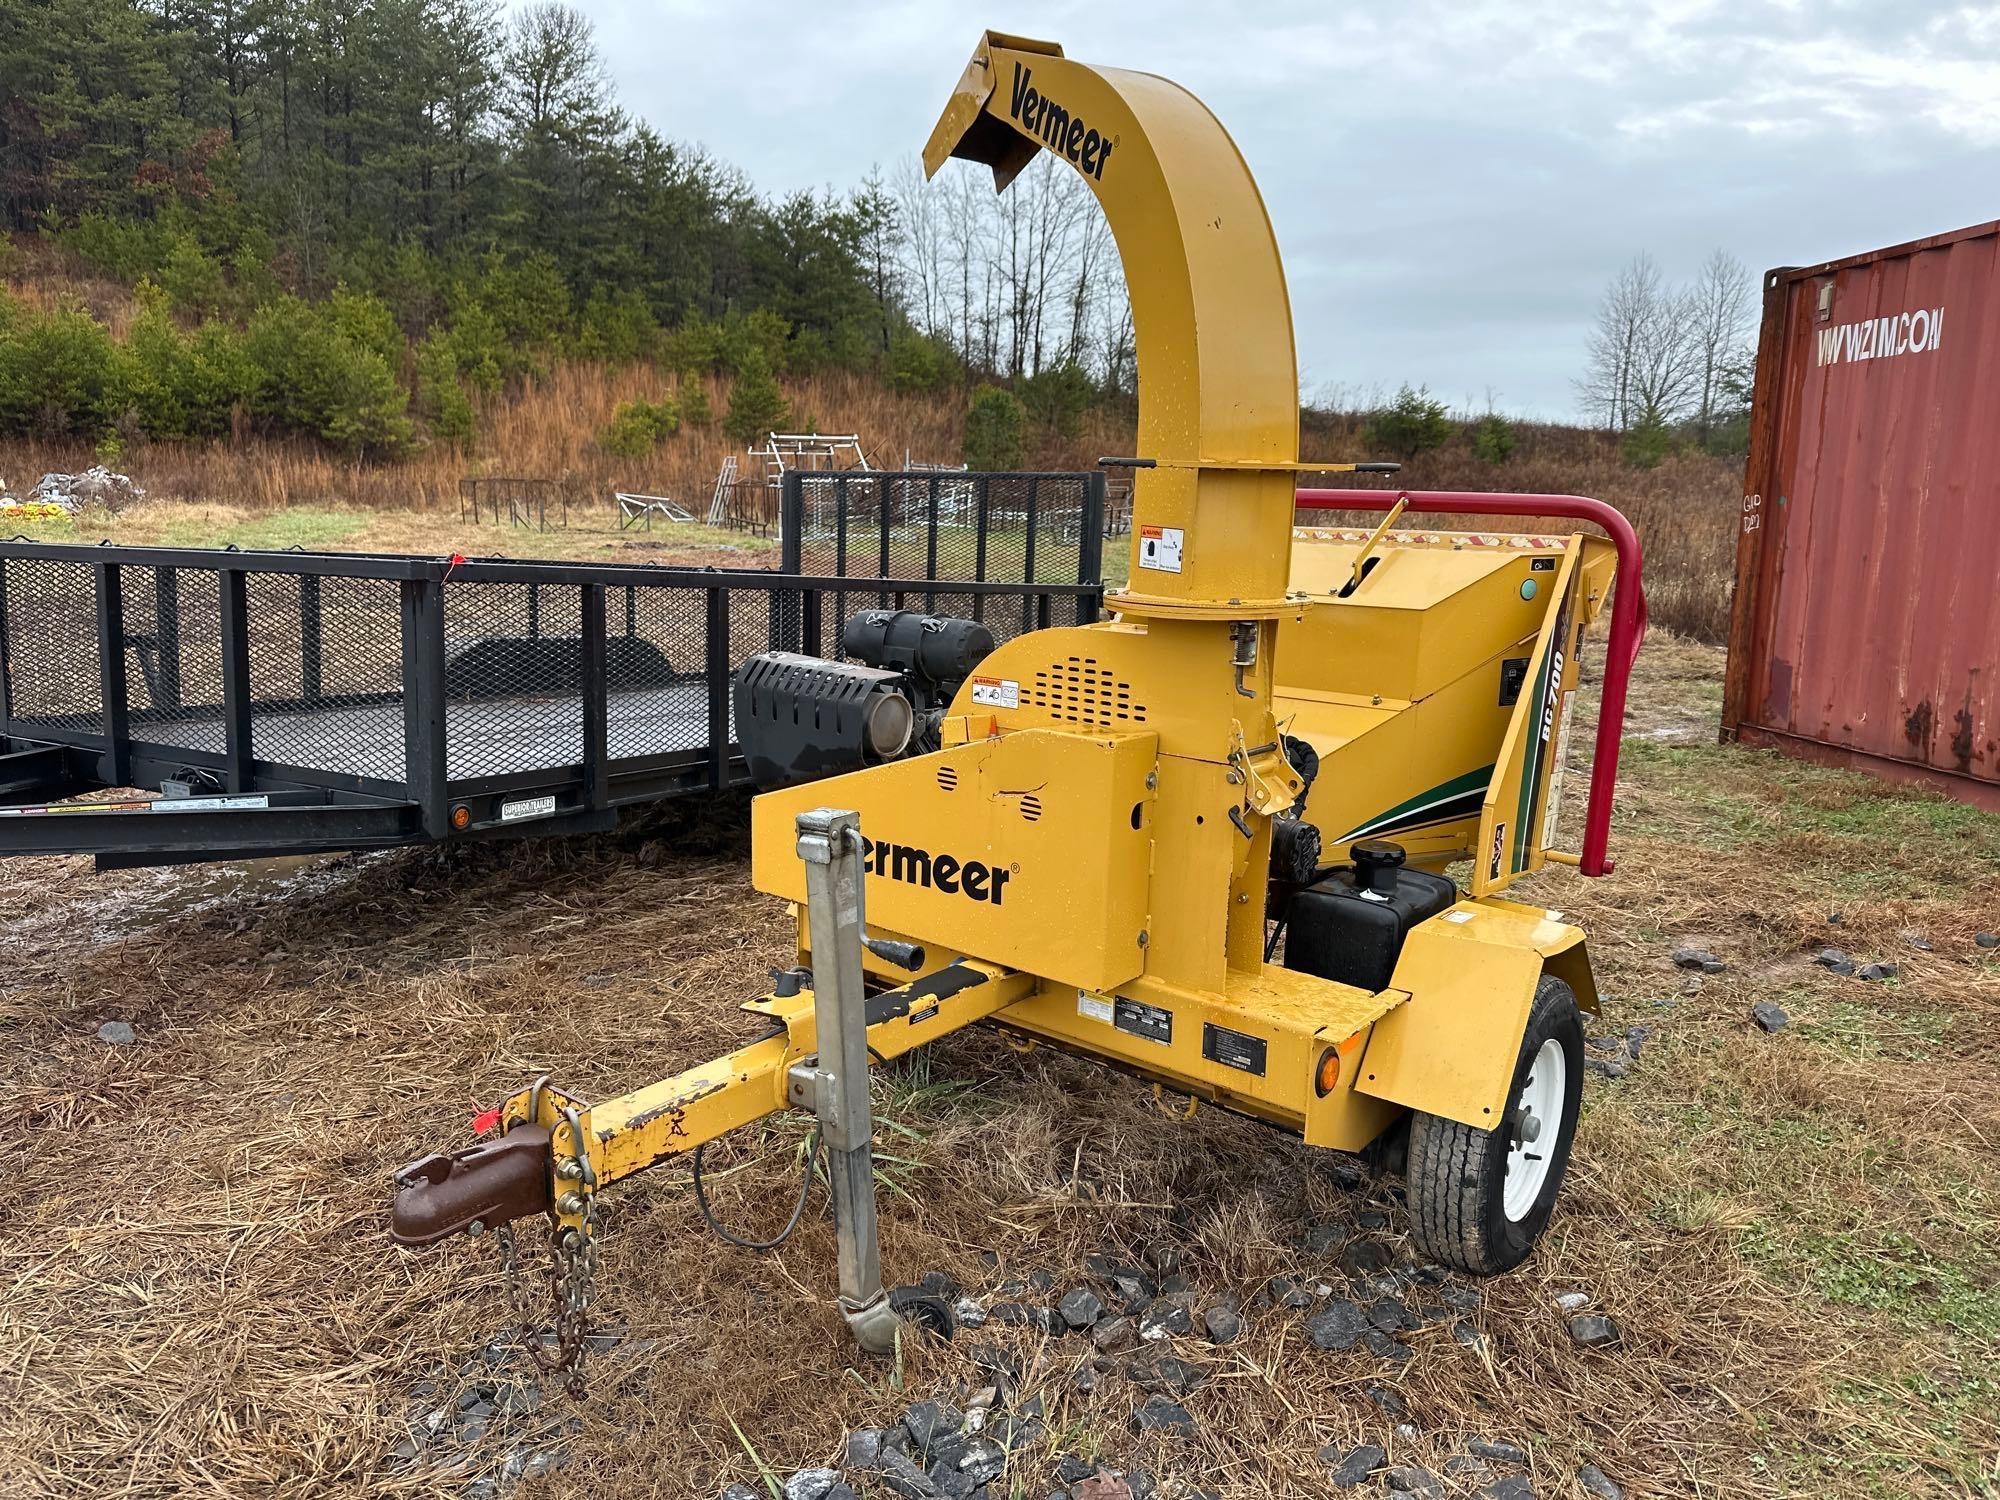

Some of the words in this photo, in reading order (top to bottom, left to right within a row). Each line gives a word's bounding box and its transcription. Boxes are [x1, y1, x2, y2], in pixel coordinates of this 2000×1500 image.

[1010, 60, 1113, 182] Vermeer
[505, 802, 529, 815] SUPERIOR
[531, 798, 553, 810] TRAILERS
